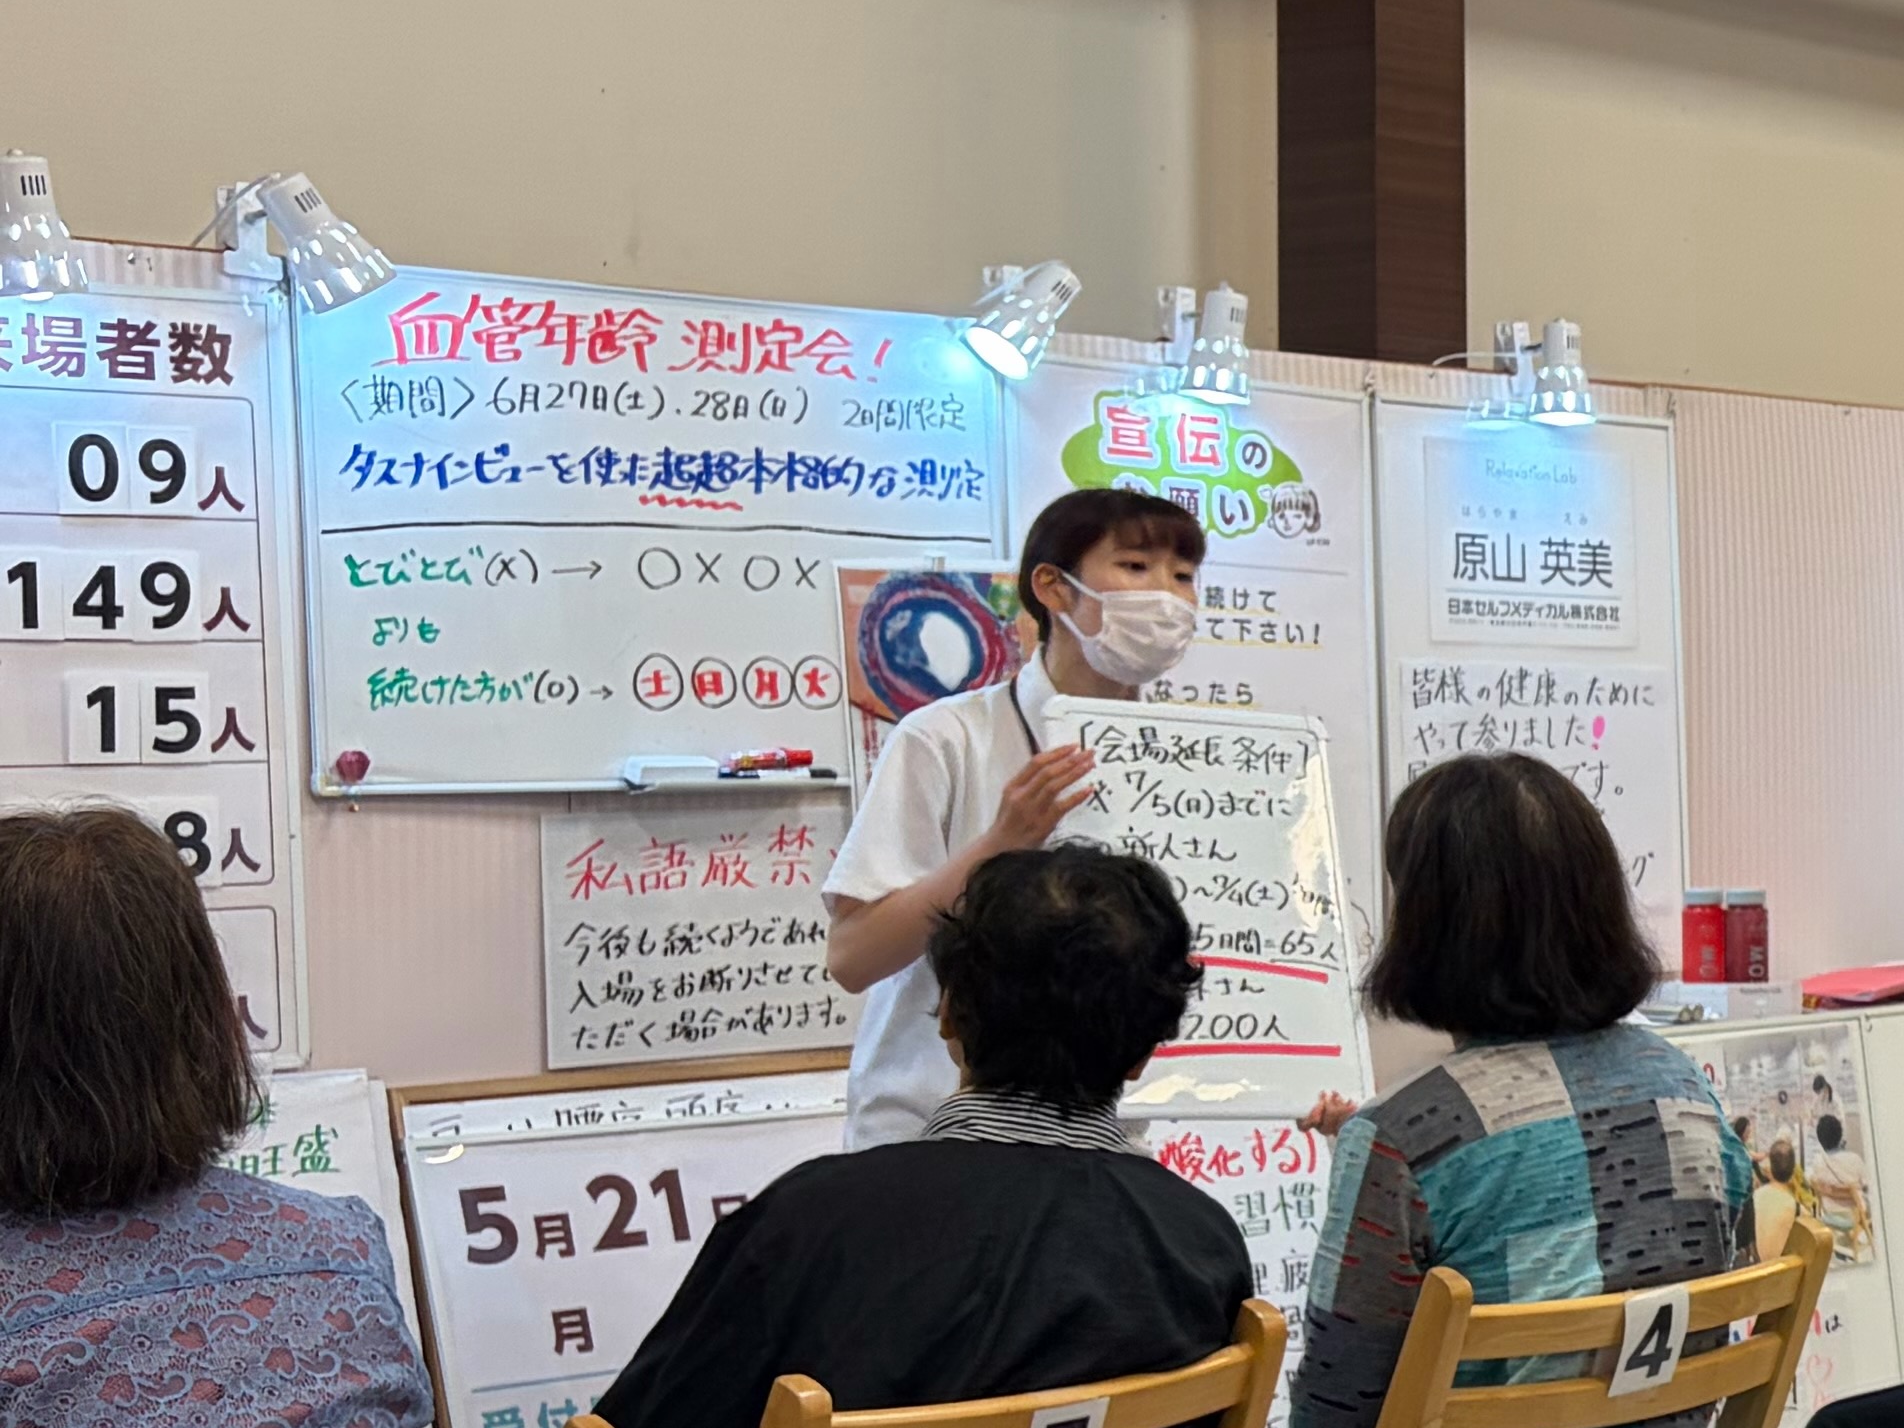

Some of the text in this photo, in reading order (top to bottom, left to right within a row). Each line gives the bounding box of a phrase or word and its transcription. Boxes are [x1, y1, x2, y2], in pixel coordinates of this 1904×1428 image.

[1453, 532, 1613, 589] 原山 英美
[372, 616, 441, 646] よりも
[1448, 597, 1620, 623] 日本セルフメディカル株式会社
[1412, 665, 1655, 709] 皆様の健康のために
[1627, 1303, 1673, 1377] 4
